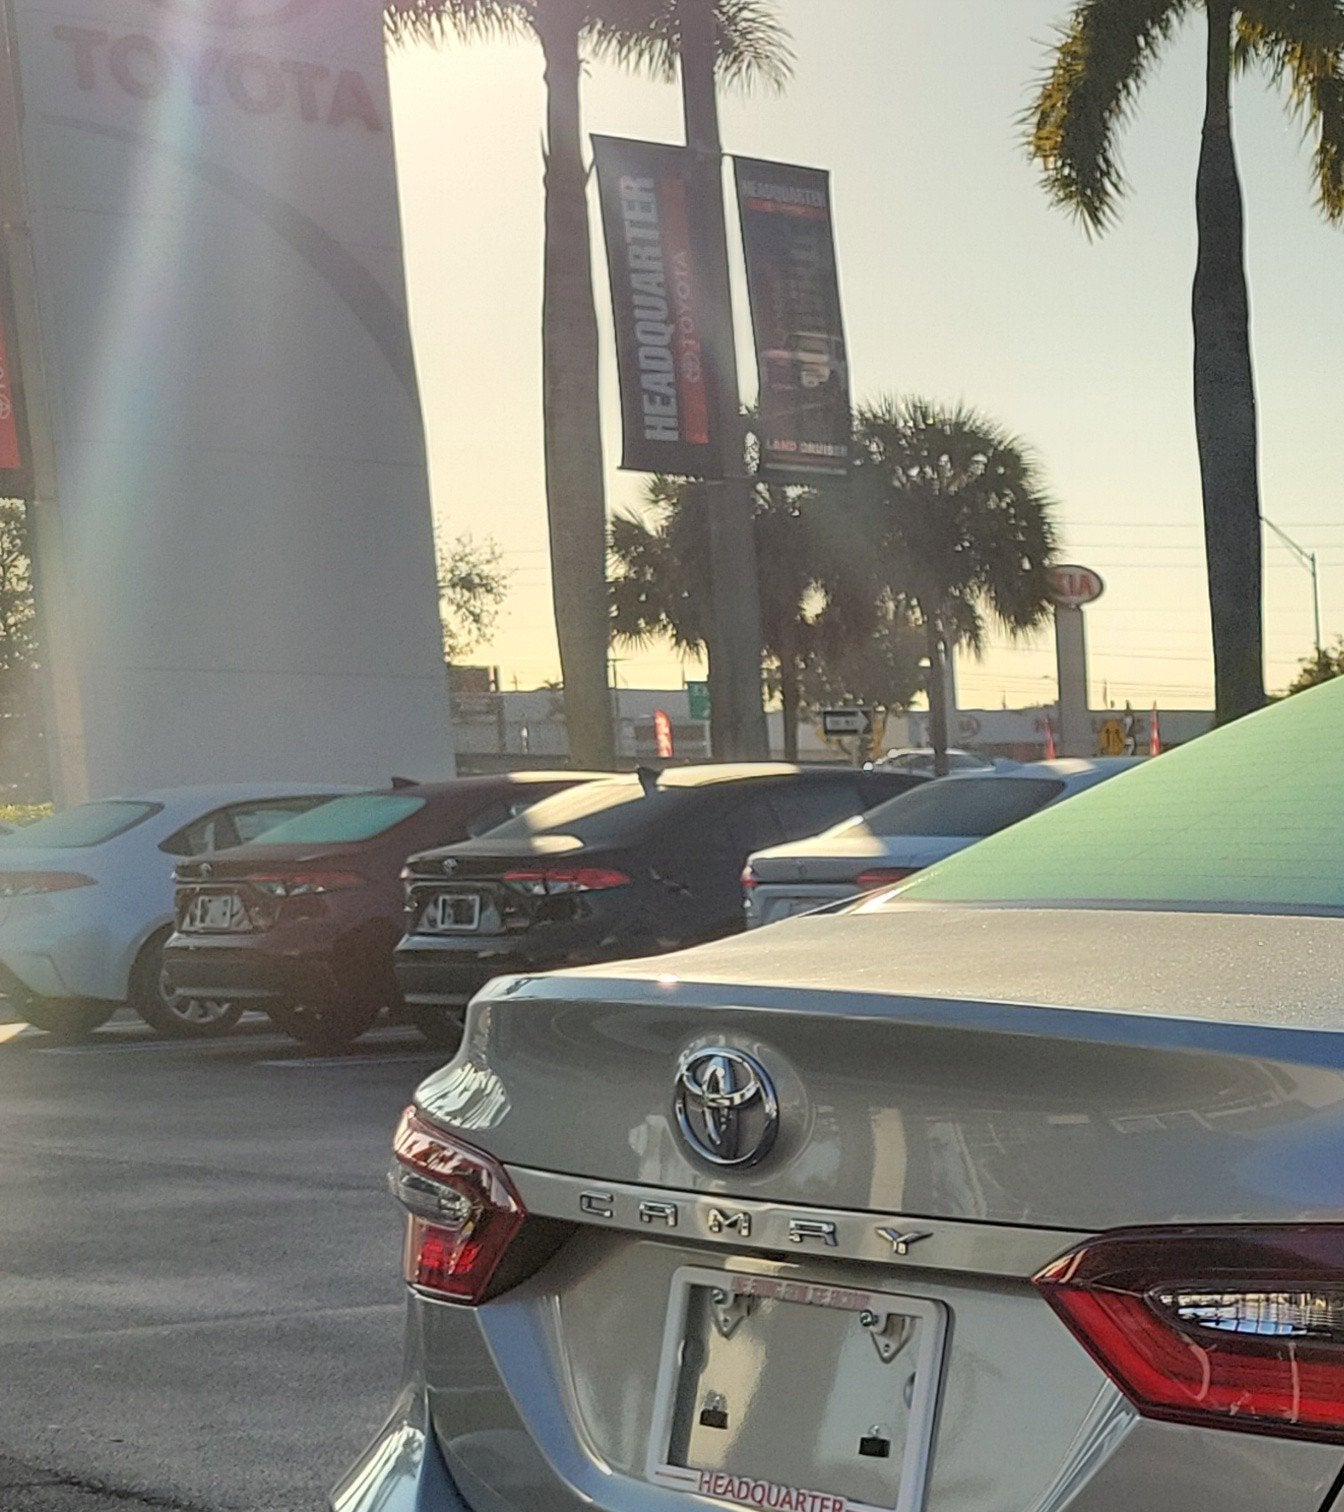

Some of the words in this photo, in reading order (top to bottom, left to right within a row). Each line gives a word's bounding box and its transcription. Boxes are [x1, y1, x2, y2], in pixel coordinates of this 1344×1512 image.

[620, 176, 679, 441] HEADQUARTER
[671, 251, 699, 346] TOYOTA
[579, 1190, 934, 1255] CAMRY
